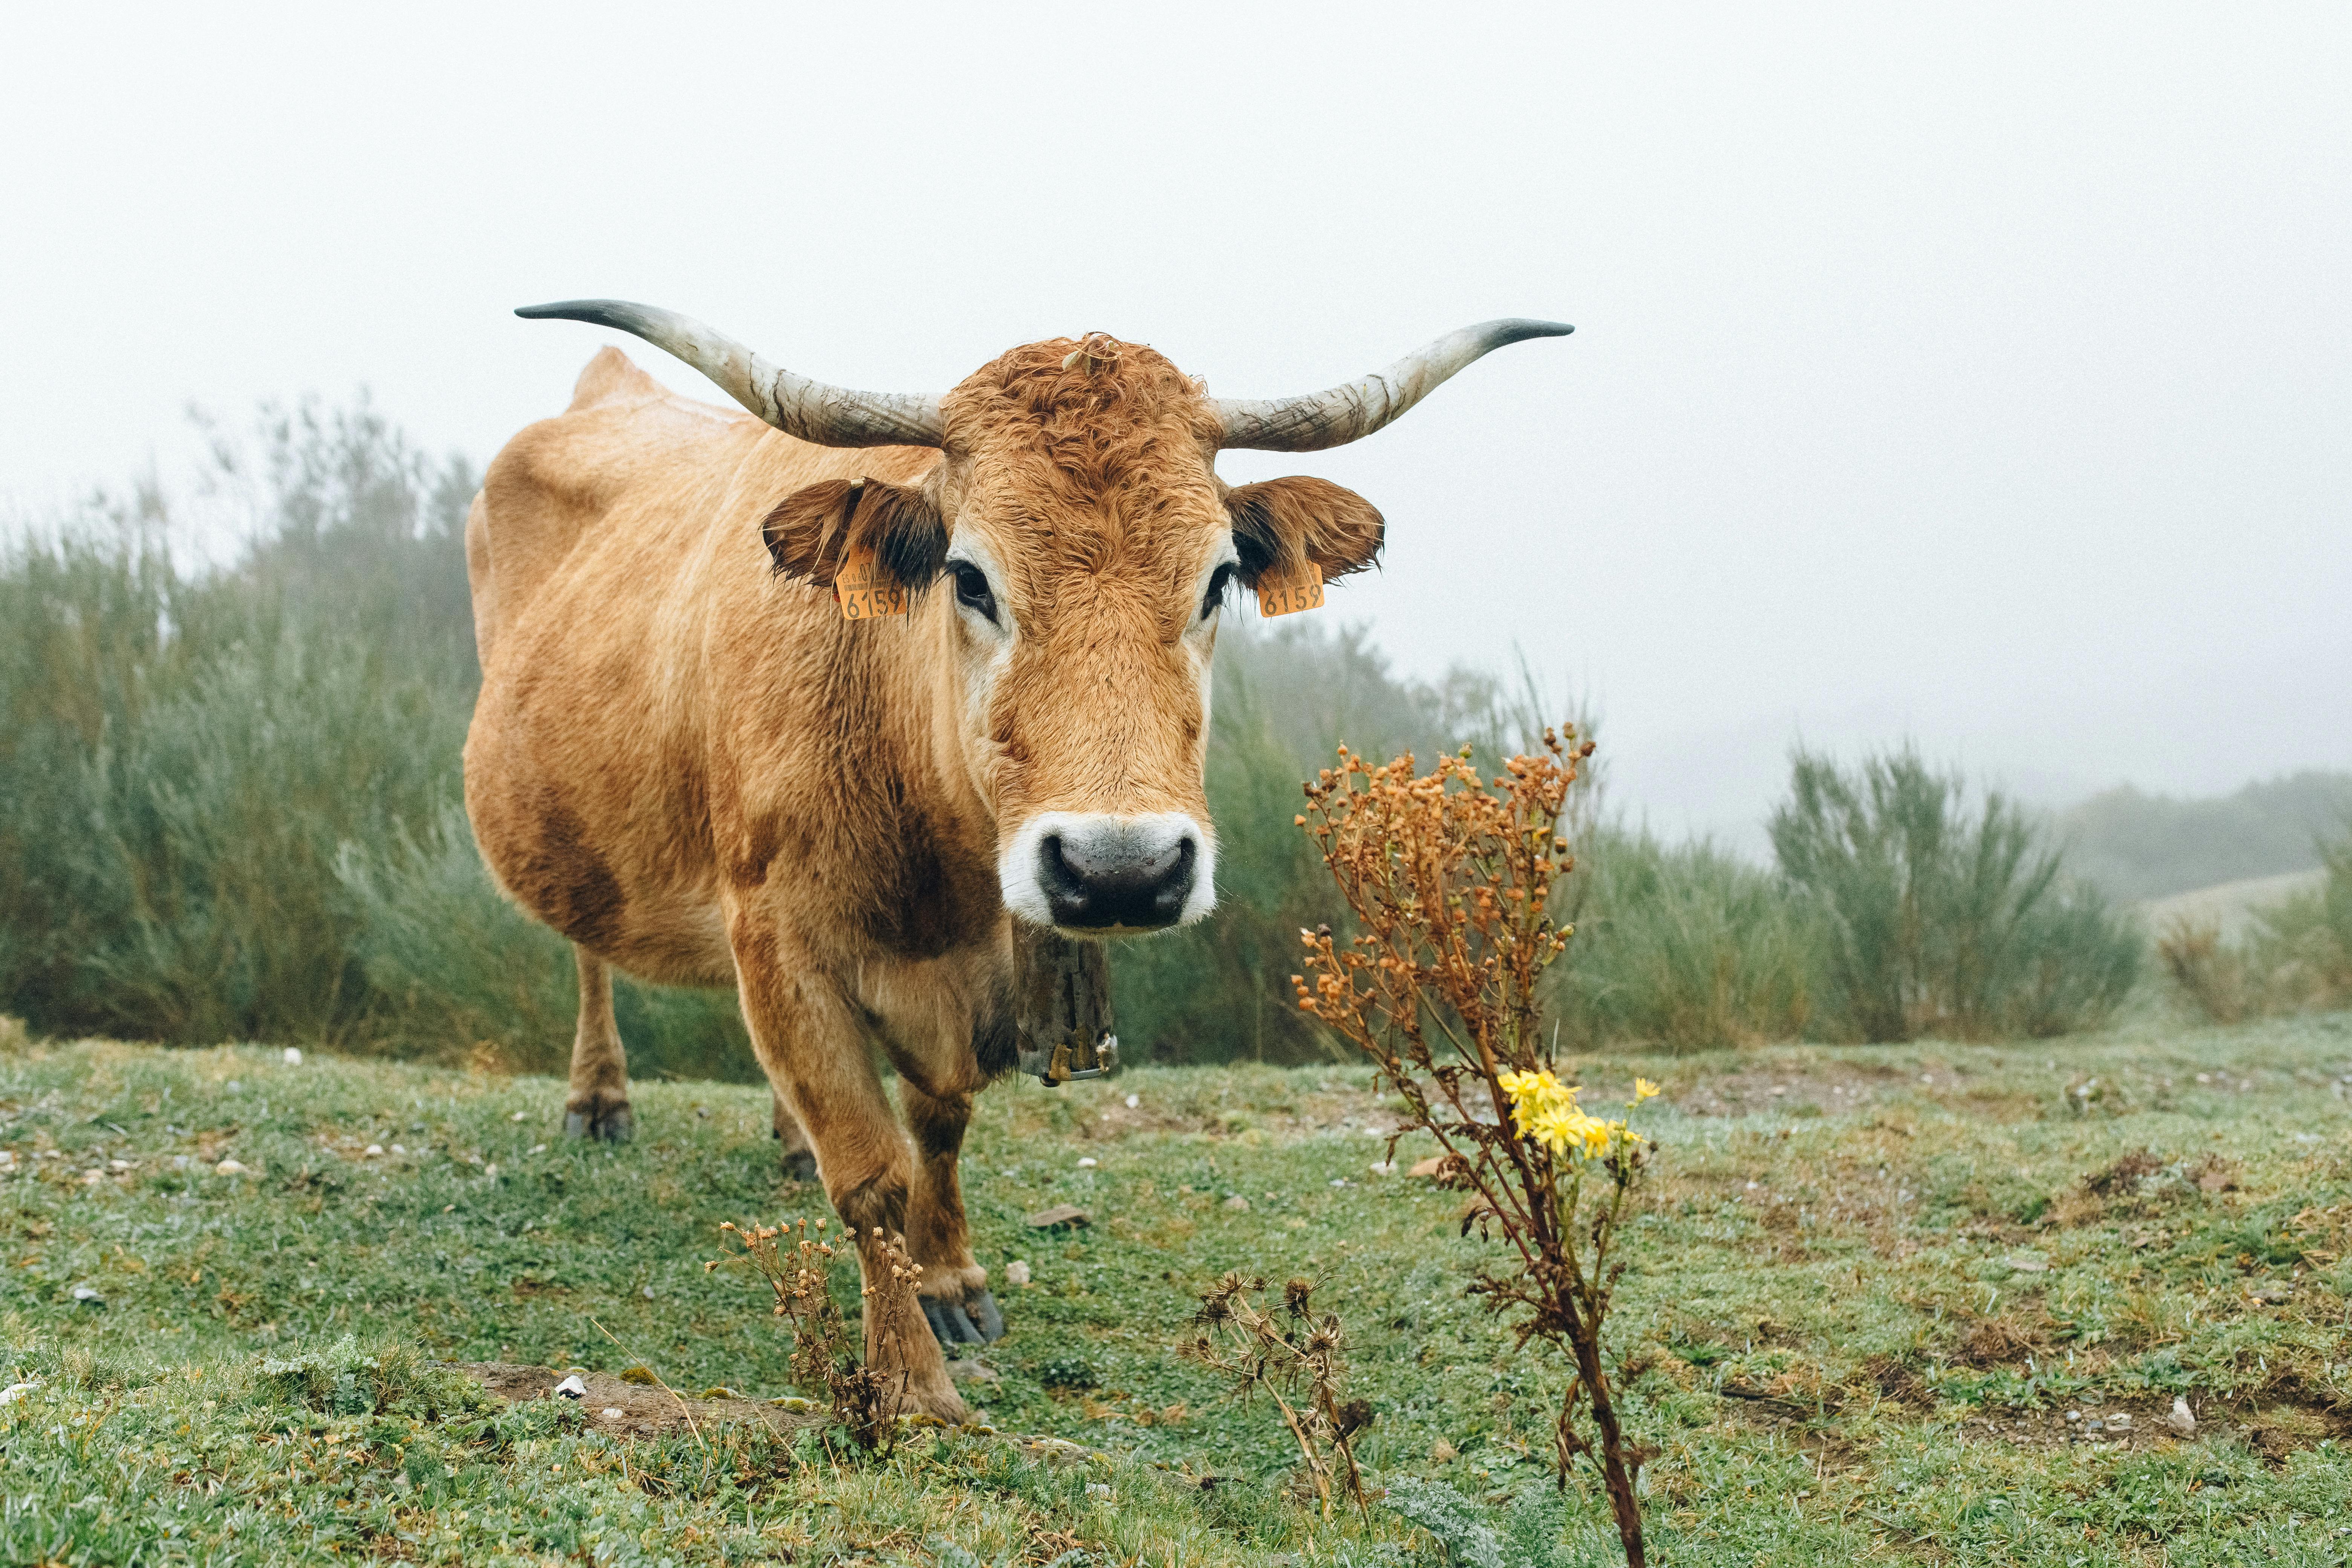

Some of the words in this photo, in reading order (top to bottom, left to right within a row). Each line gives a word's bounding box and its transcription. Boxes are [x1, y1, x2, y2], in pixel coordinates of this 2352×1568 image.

[842, 574, 850, 583] ES
[847, 588, 900, 618] 6159
[1265, 584, 1321, 615] 6159
